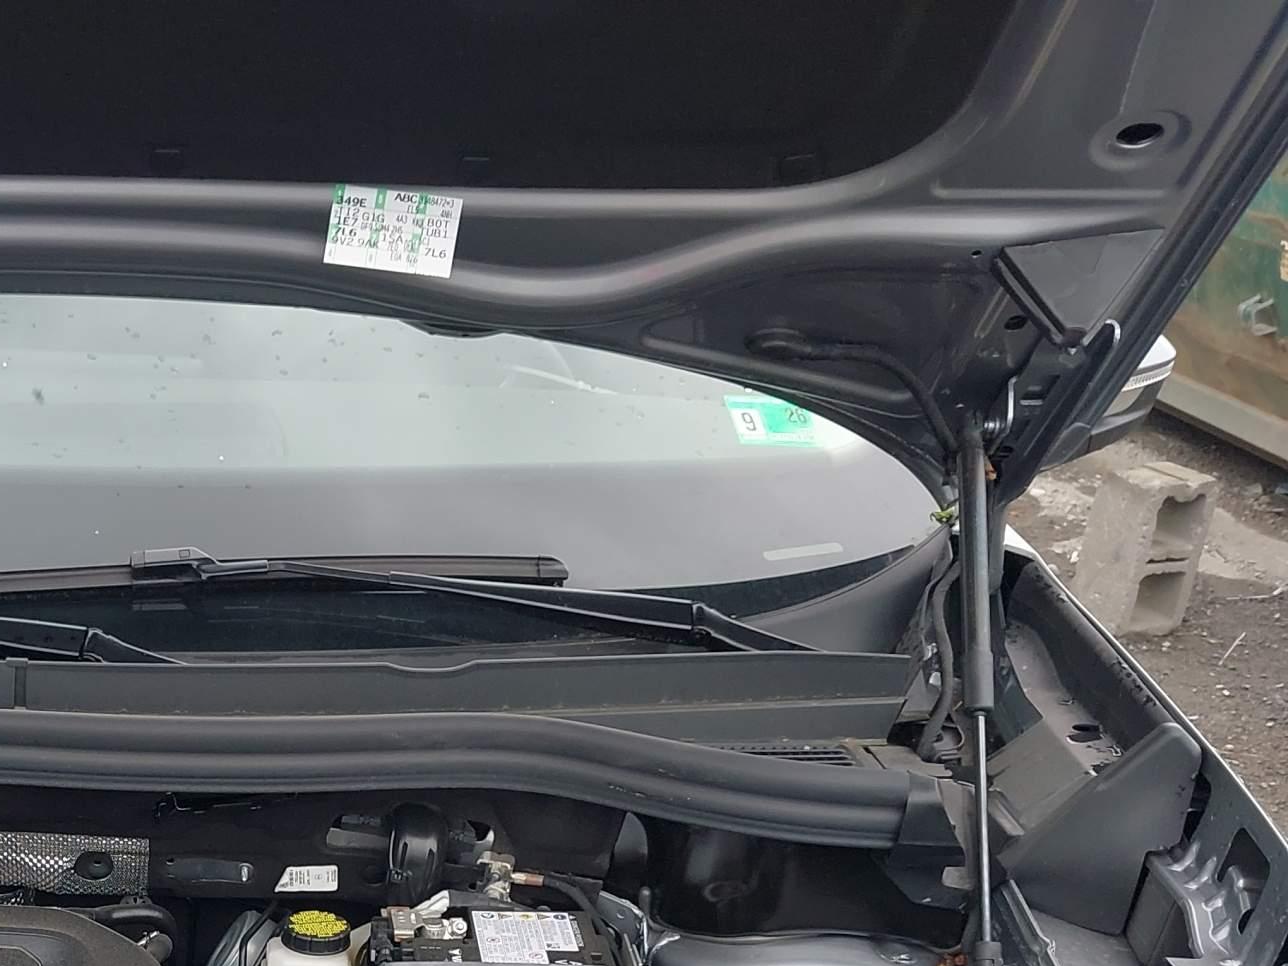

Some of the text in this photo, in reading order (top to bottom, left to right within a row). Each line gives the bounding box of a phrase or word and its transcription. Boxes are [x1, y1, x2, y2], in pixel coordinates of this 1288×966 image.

[336, 195, 367, 208] 349E
[394, 192, 418, 204] ABC
[424, 248, 447, 259] 7L6
[741, 412, 757, 432] 9
